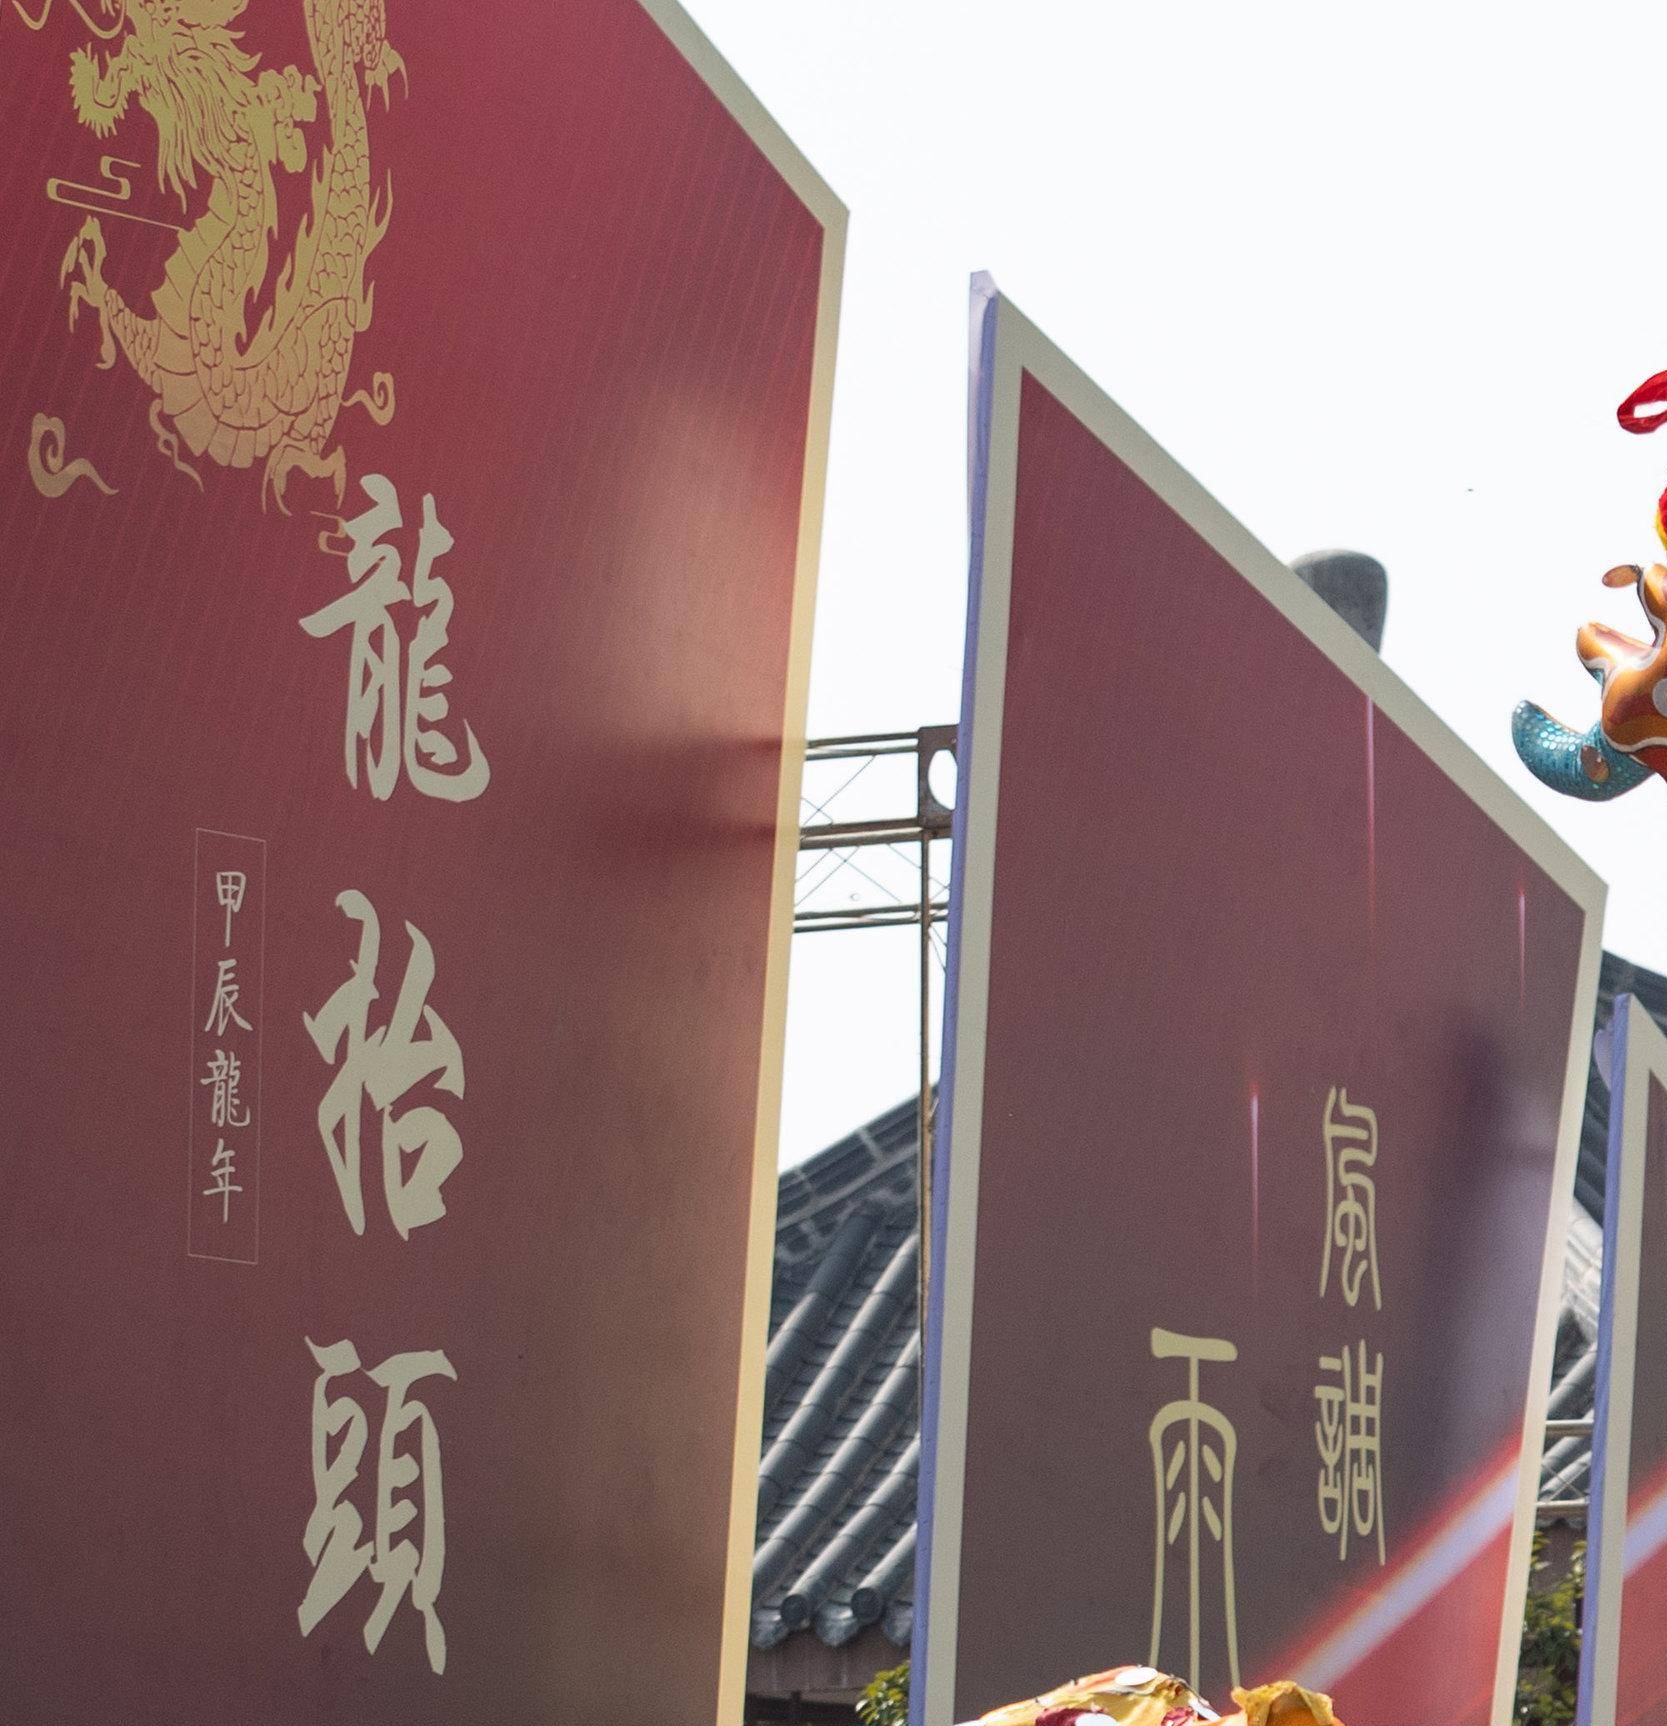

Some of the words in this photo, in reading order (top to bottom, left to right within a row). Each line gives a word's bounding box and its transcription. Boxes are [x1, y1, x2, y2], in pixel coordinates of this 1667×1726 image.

[198, 870, 254, 1223] 甲辰龍年
[1148, 1327, 1240, 1686] 雨
